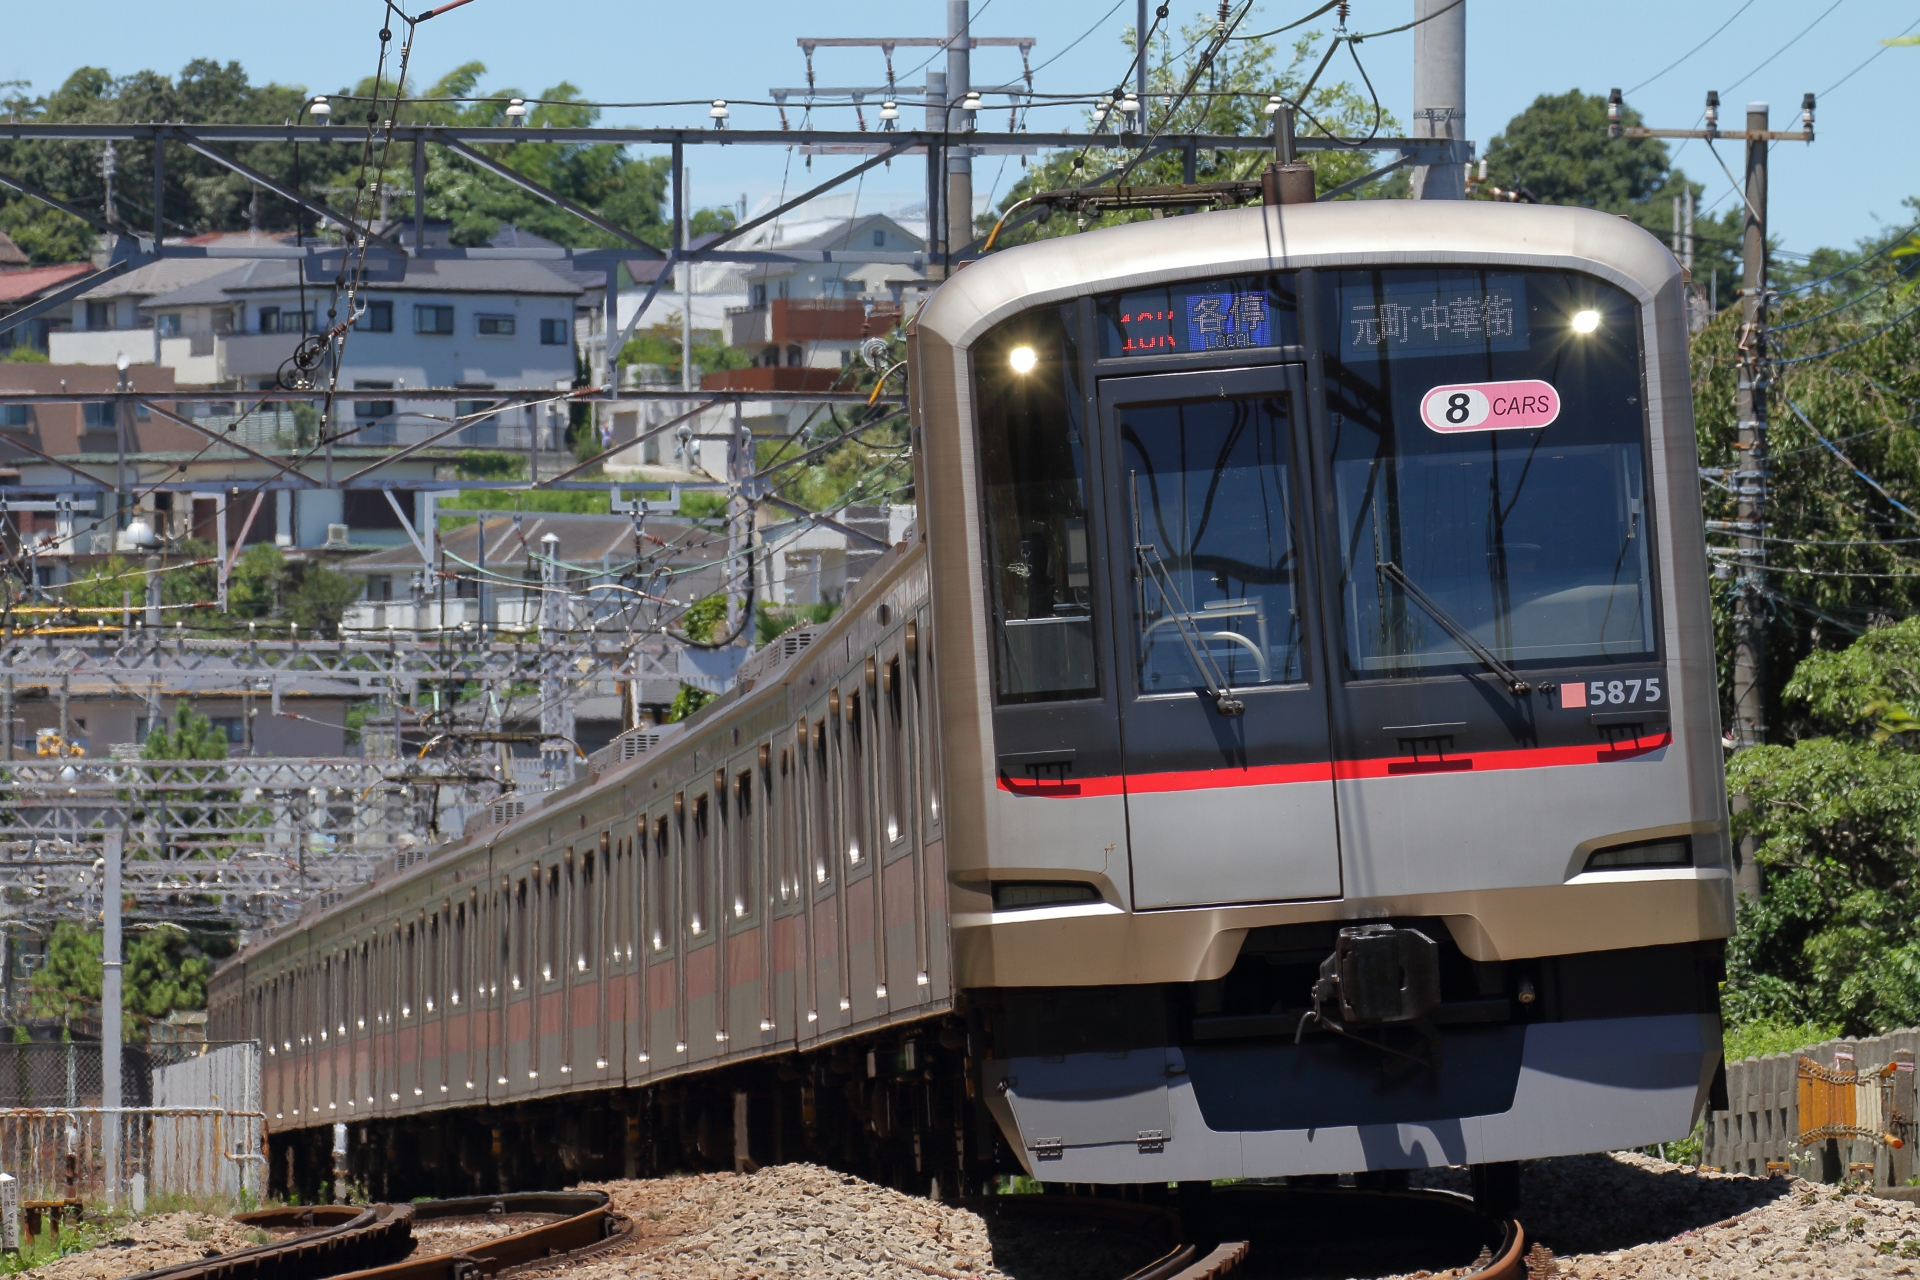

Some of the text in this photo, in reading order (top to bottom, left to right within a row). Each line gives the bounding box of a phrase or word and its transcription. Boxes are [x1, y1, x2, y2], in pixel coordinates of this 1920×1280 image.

[1193, 295, 1265, 333] 各停
[1206, 332, 1257, 349] LOCAL
[1445, 393, 1550, 424] 8 CARS
[1590, 678, 1661, 706] 5875
